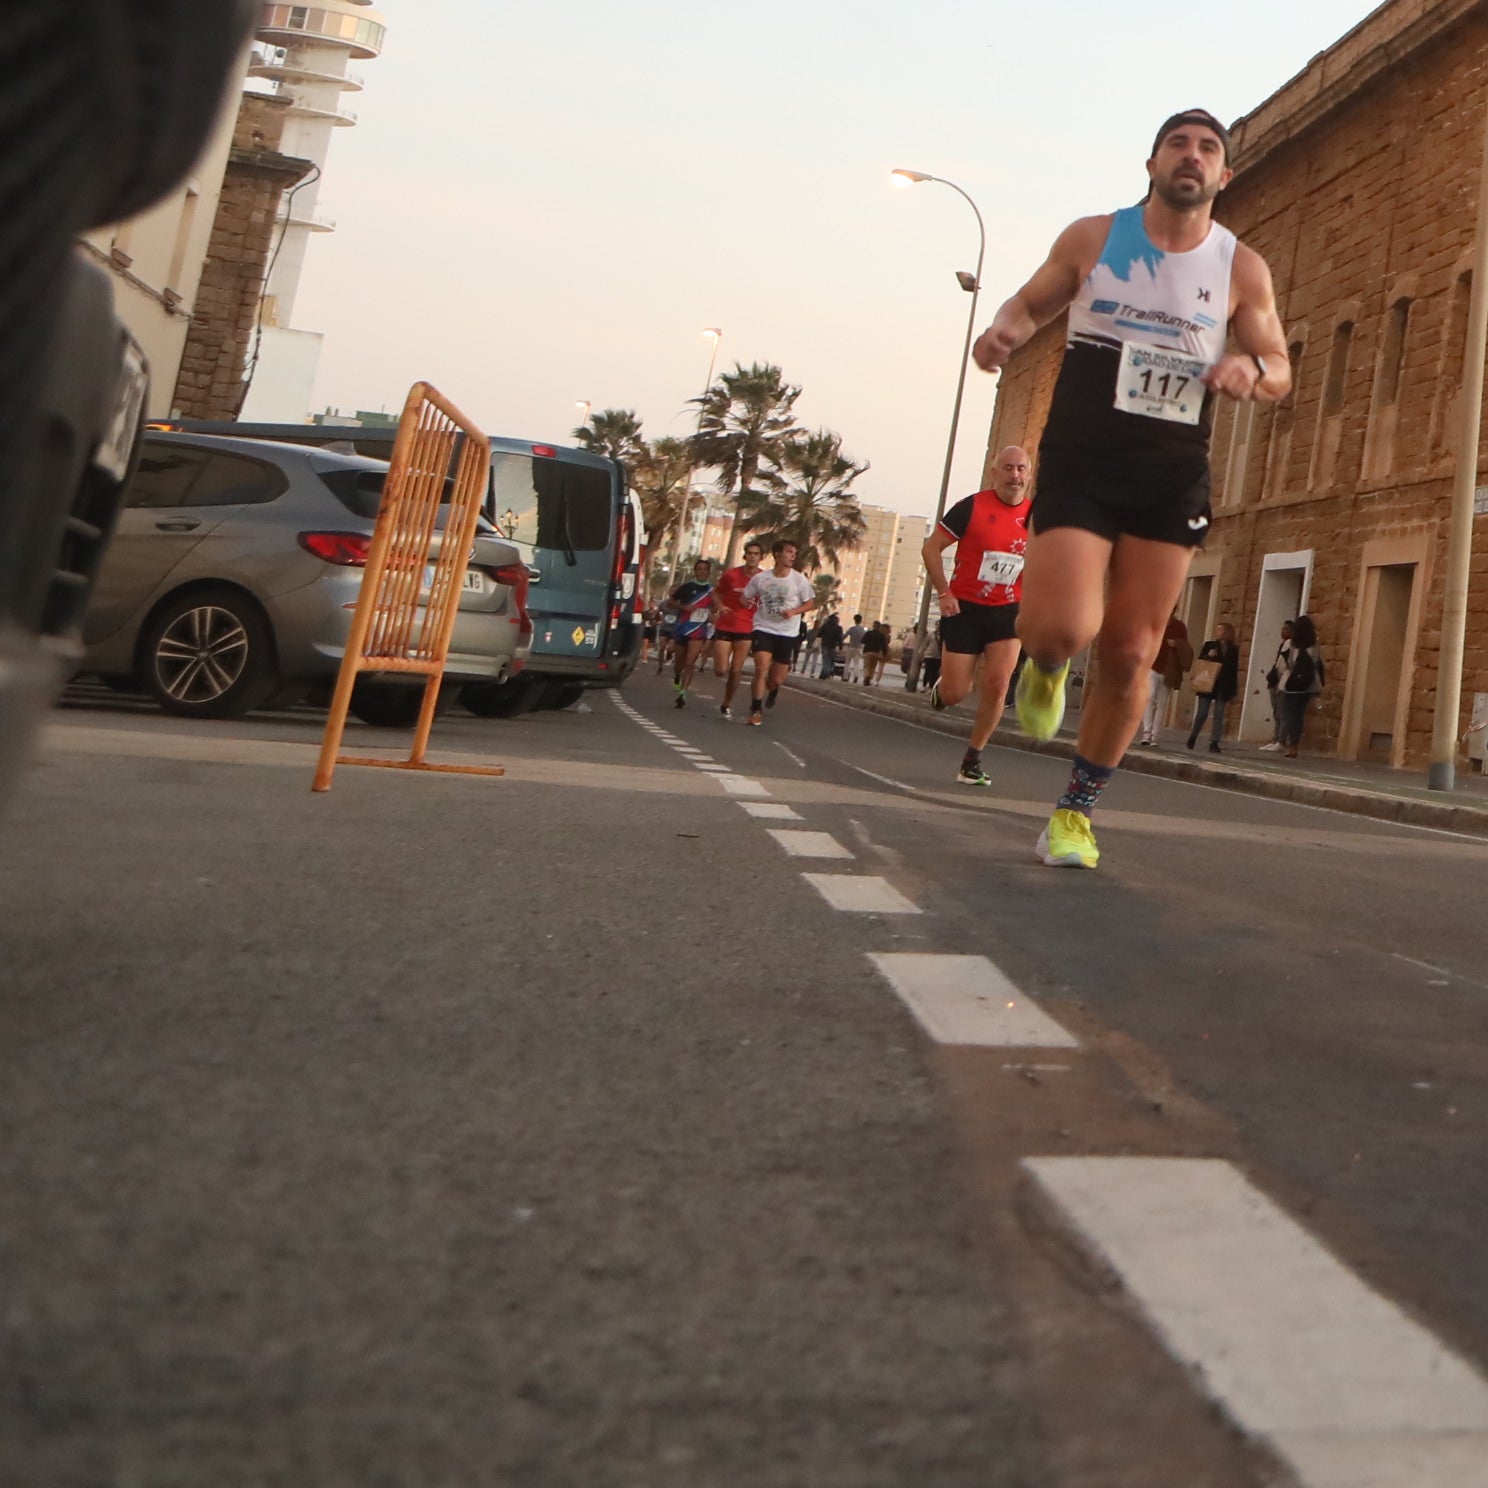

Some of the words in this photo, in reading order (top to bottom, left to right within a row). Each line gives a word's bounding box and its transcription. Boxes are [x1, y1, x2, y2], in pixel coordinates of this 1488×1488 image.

[1120, 305, 1206, 332] TrailRunner
[1140, 369, 1190, 399] 117
[991, 561, 1016, 576] 477
